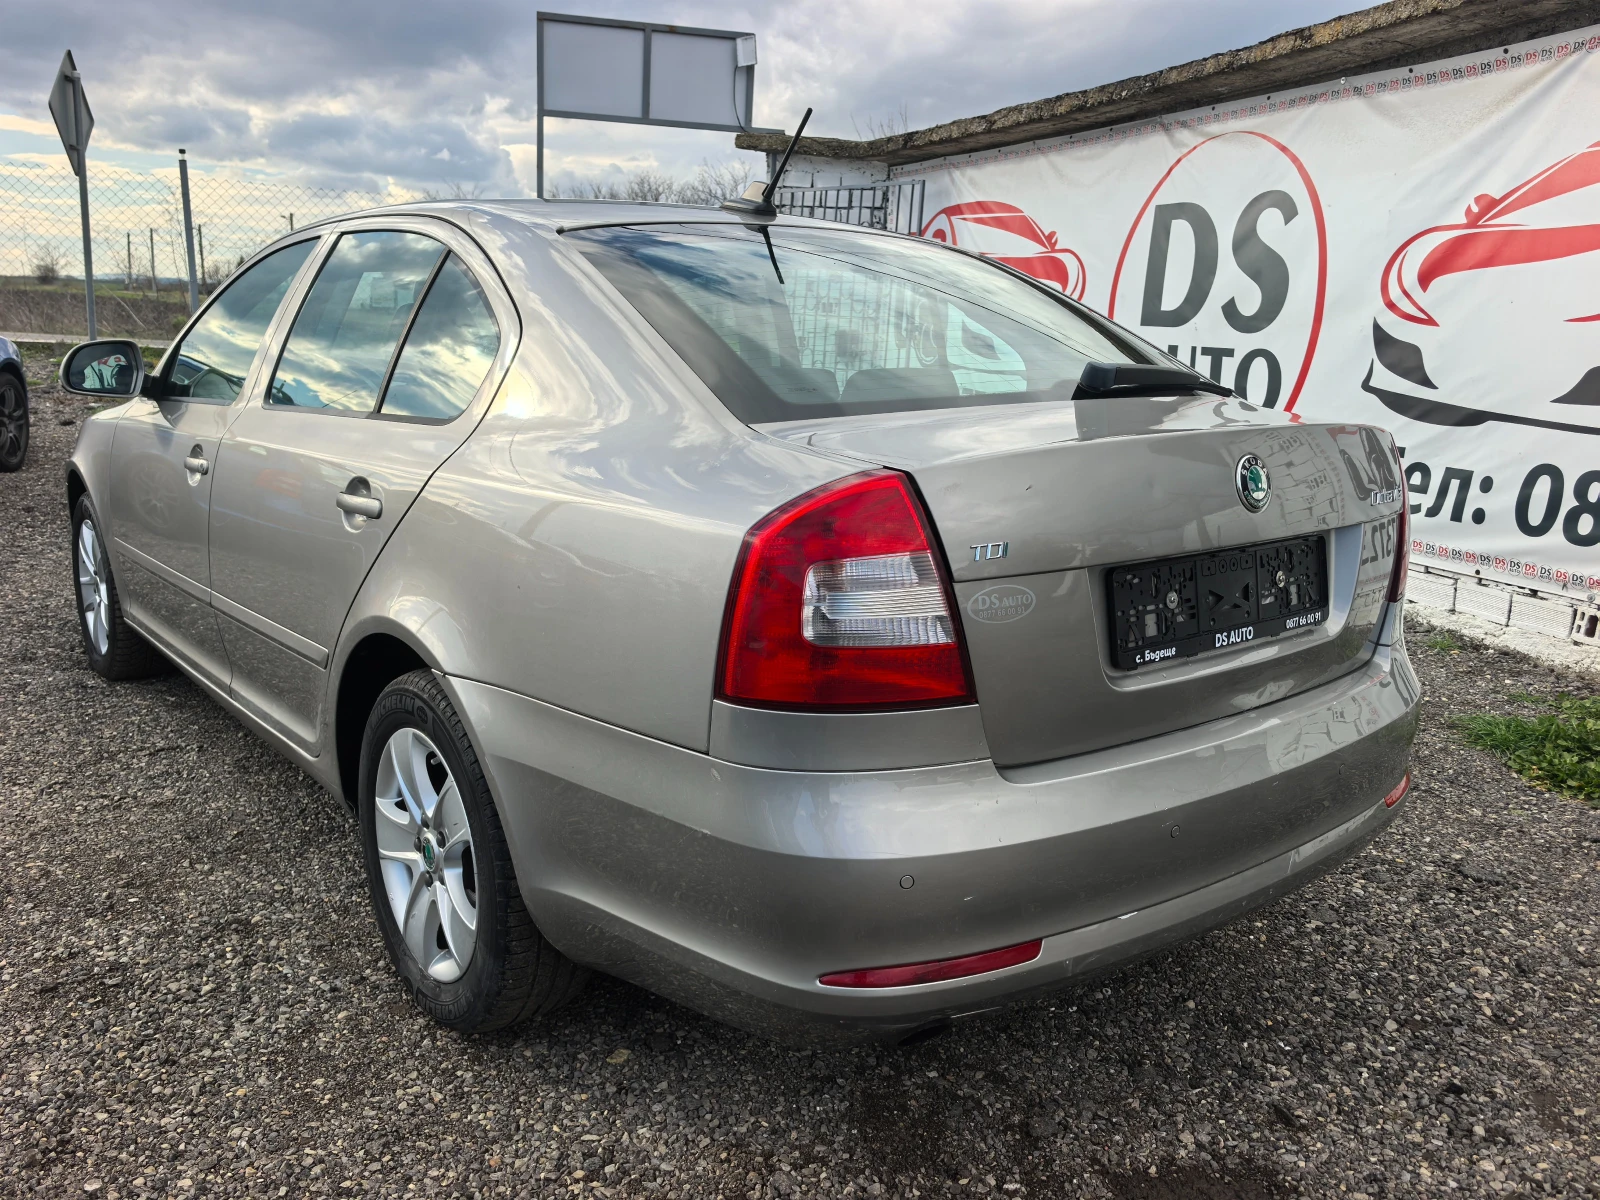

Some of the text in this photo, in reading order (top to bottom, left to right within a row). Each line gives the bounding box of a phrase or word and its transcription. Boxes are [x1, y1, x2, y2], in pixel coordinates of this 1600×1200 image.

[1140, 190, 1299, 334] DS
[1396, 446, 1494, 525] ел:
[970, 541, 1009, 561] TDI
[978, 594, 1032, 609] DS AUTO
[980, 610, 996, 619] 0877
[1286, 612, 1321, 629] 0877 66 00 91
[1215, 626, 1254, 647] DS AUTO
[1144, 647, 1176, 661] Бъдеще
[370, 695, 415, 728] MICHELIN
